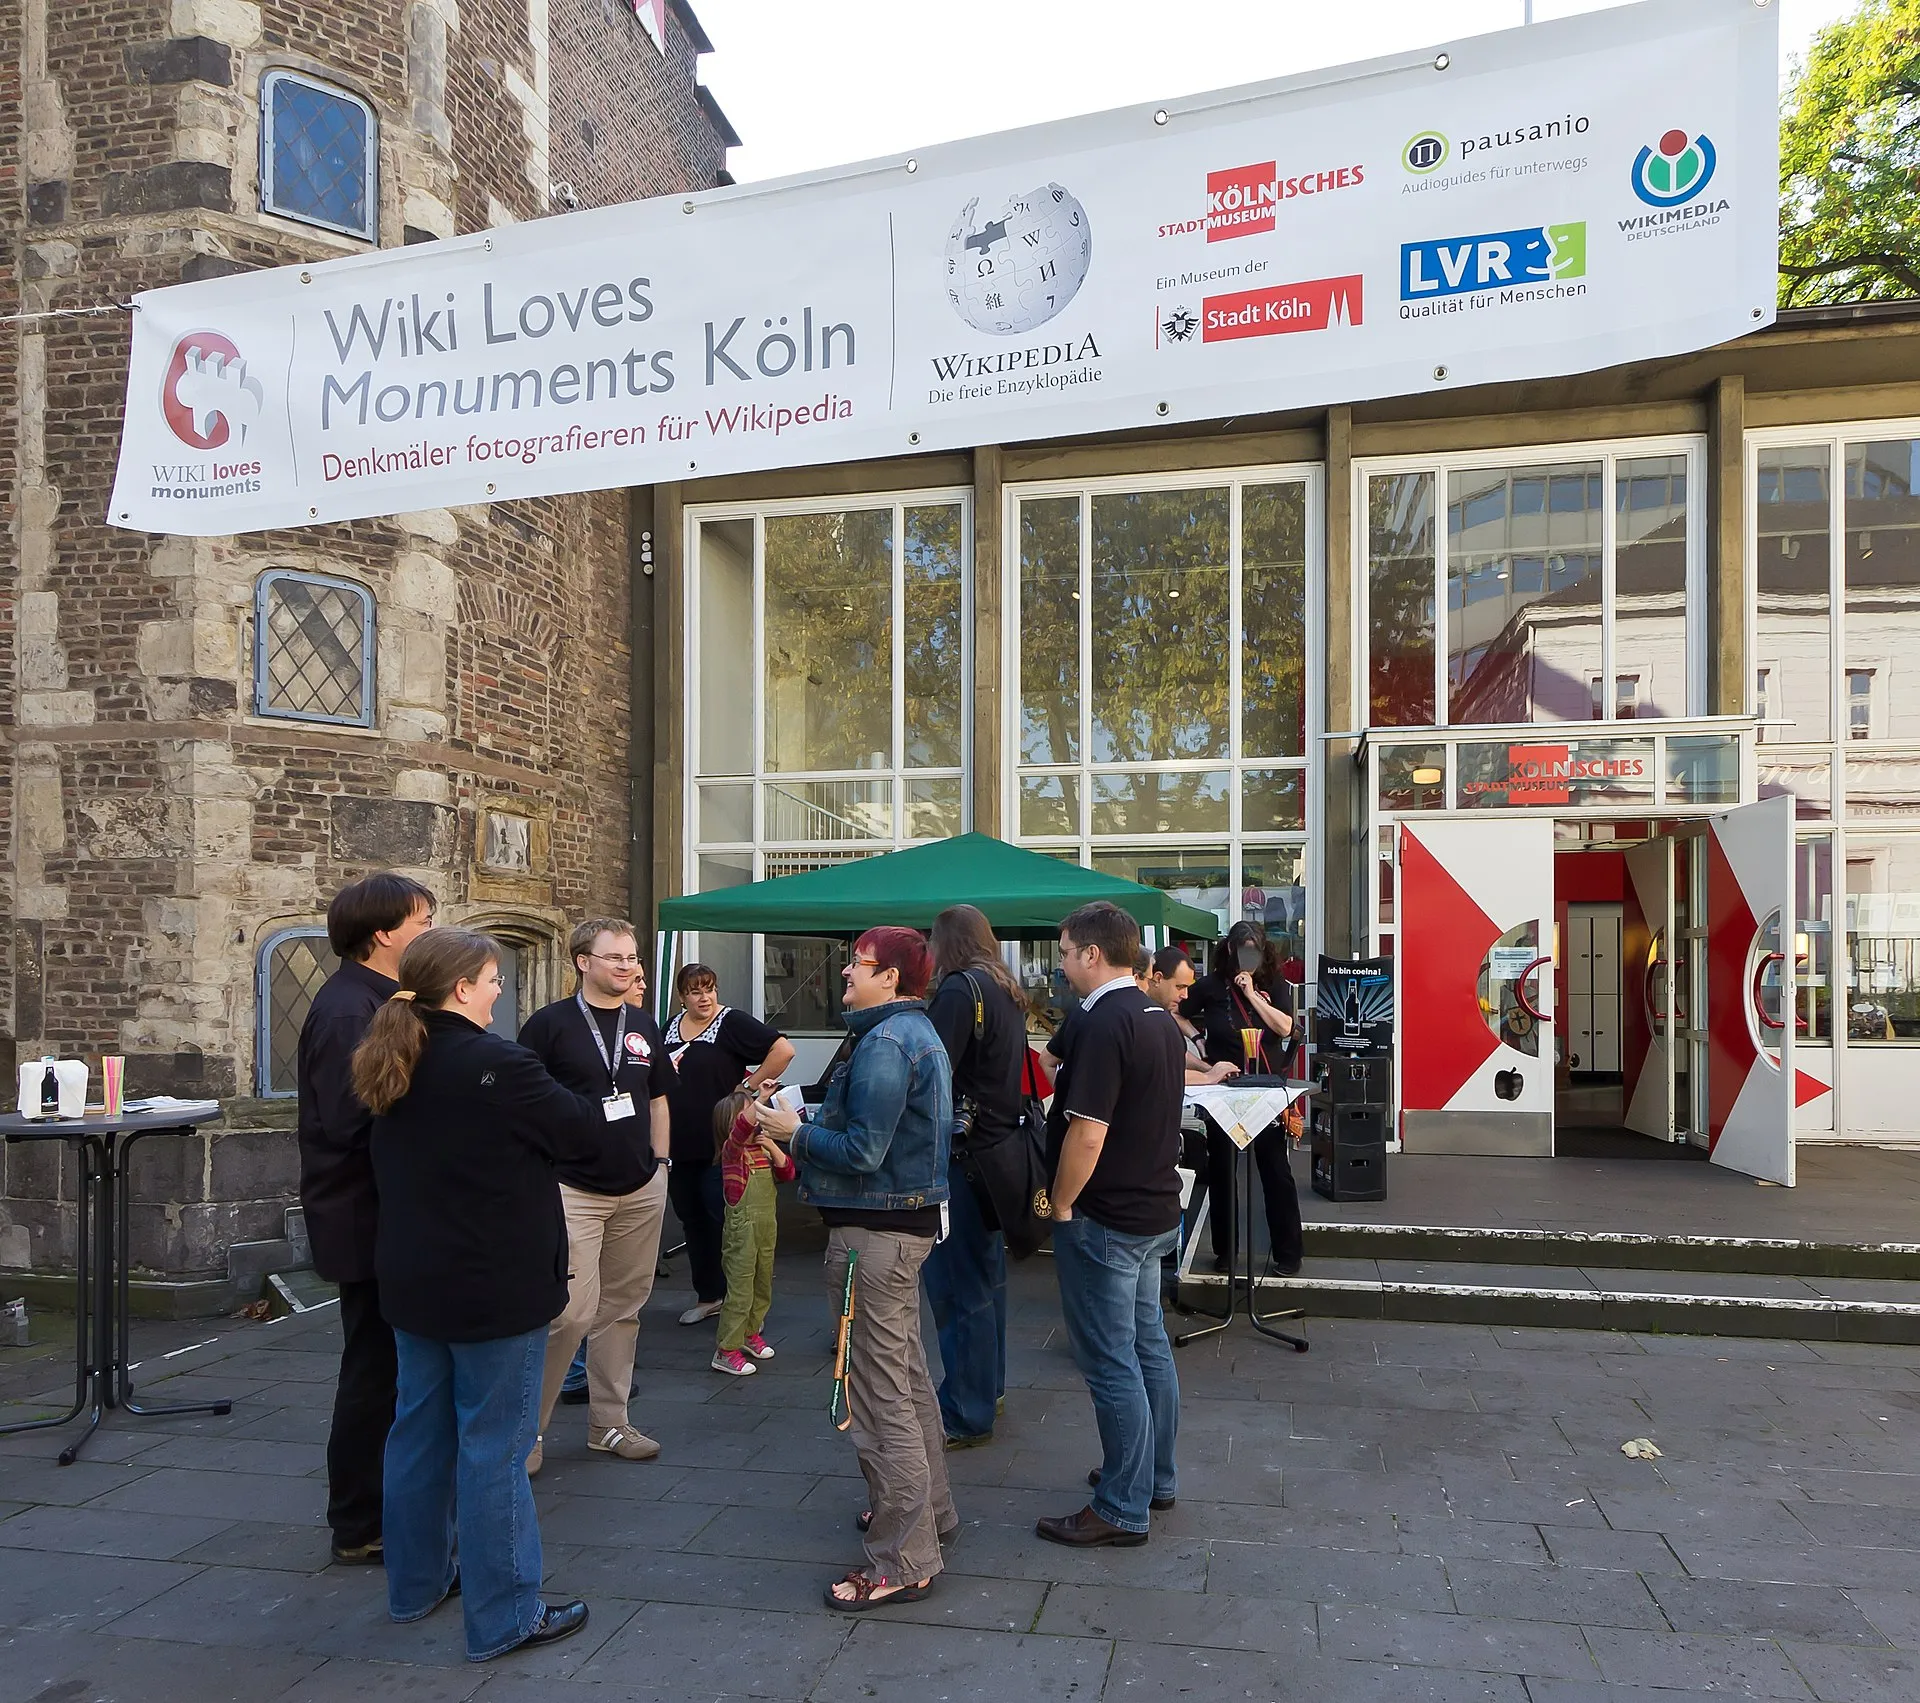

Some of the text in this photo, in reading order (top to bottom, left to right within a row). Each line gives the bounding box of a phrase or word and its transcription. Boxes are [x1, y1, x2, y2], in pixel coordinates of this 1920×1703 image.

[1460, 114, 1590, 159] pausanio
[1207, 164, 1365, 213] KÖLNISCHES
[1401, 156, 1588, 195] Audioguides für unterwegs
[1158, 204, 1276, 238] STADTMUSEUM
[1617, 198, 1730, 232] WIKIMEDIA
[1627, 215, 1721, 242] DEUTSCHLAND
[1156, 260, 1269, 290] Ein Museum der
[1409, 241, 1512, 293] LVR
[324, 276, 655, 364] Wiki Loves
[1207, 297, 1311, 329] Stadt Köln
[1399, 283, 1587, 320] Qualität für Menschen
[322, 307, 856, 431] Monuments Köln
[931, 332, 1103, 383] WIKIPEDIA
[928, 367, 1103, 404] Die freie Enzyklopädie
[323, 394, 854, 483] Denkmäler fotografieren für Wikipedia
[150, 477, 262, 500] monuments
[151, 459, 262, 484] WIKI loves
[1509, 757, 1644, 778] KÖLNISCHES
[1327, 967, 1338, 975] Ich
[1338, 967, 1351, 975] bin
